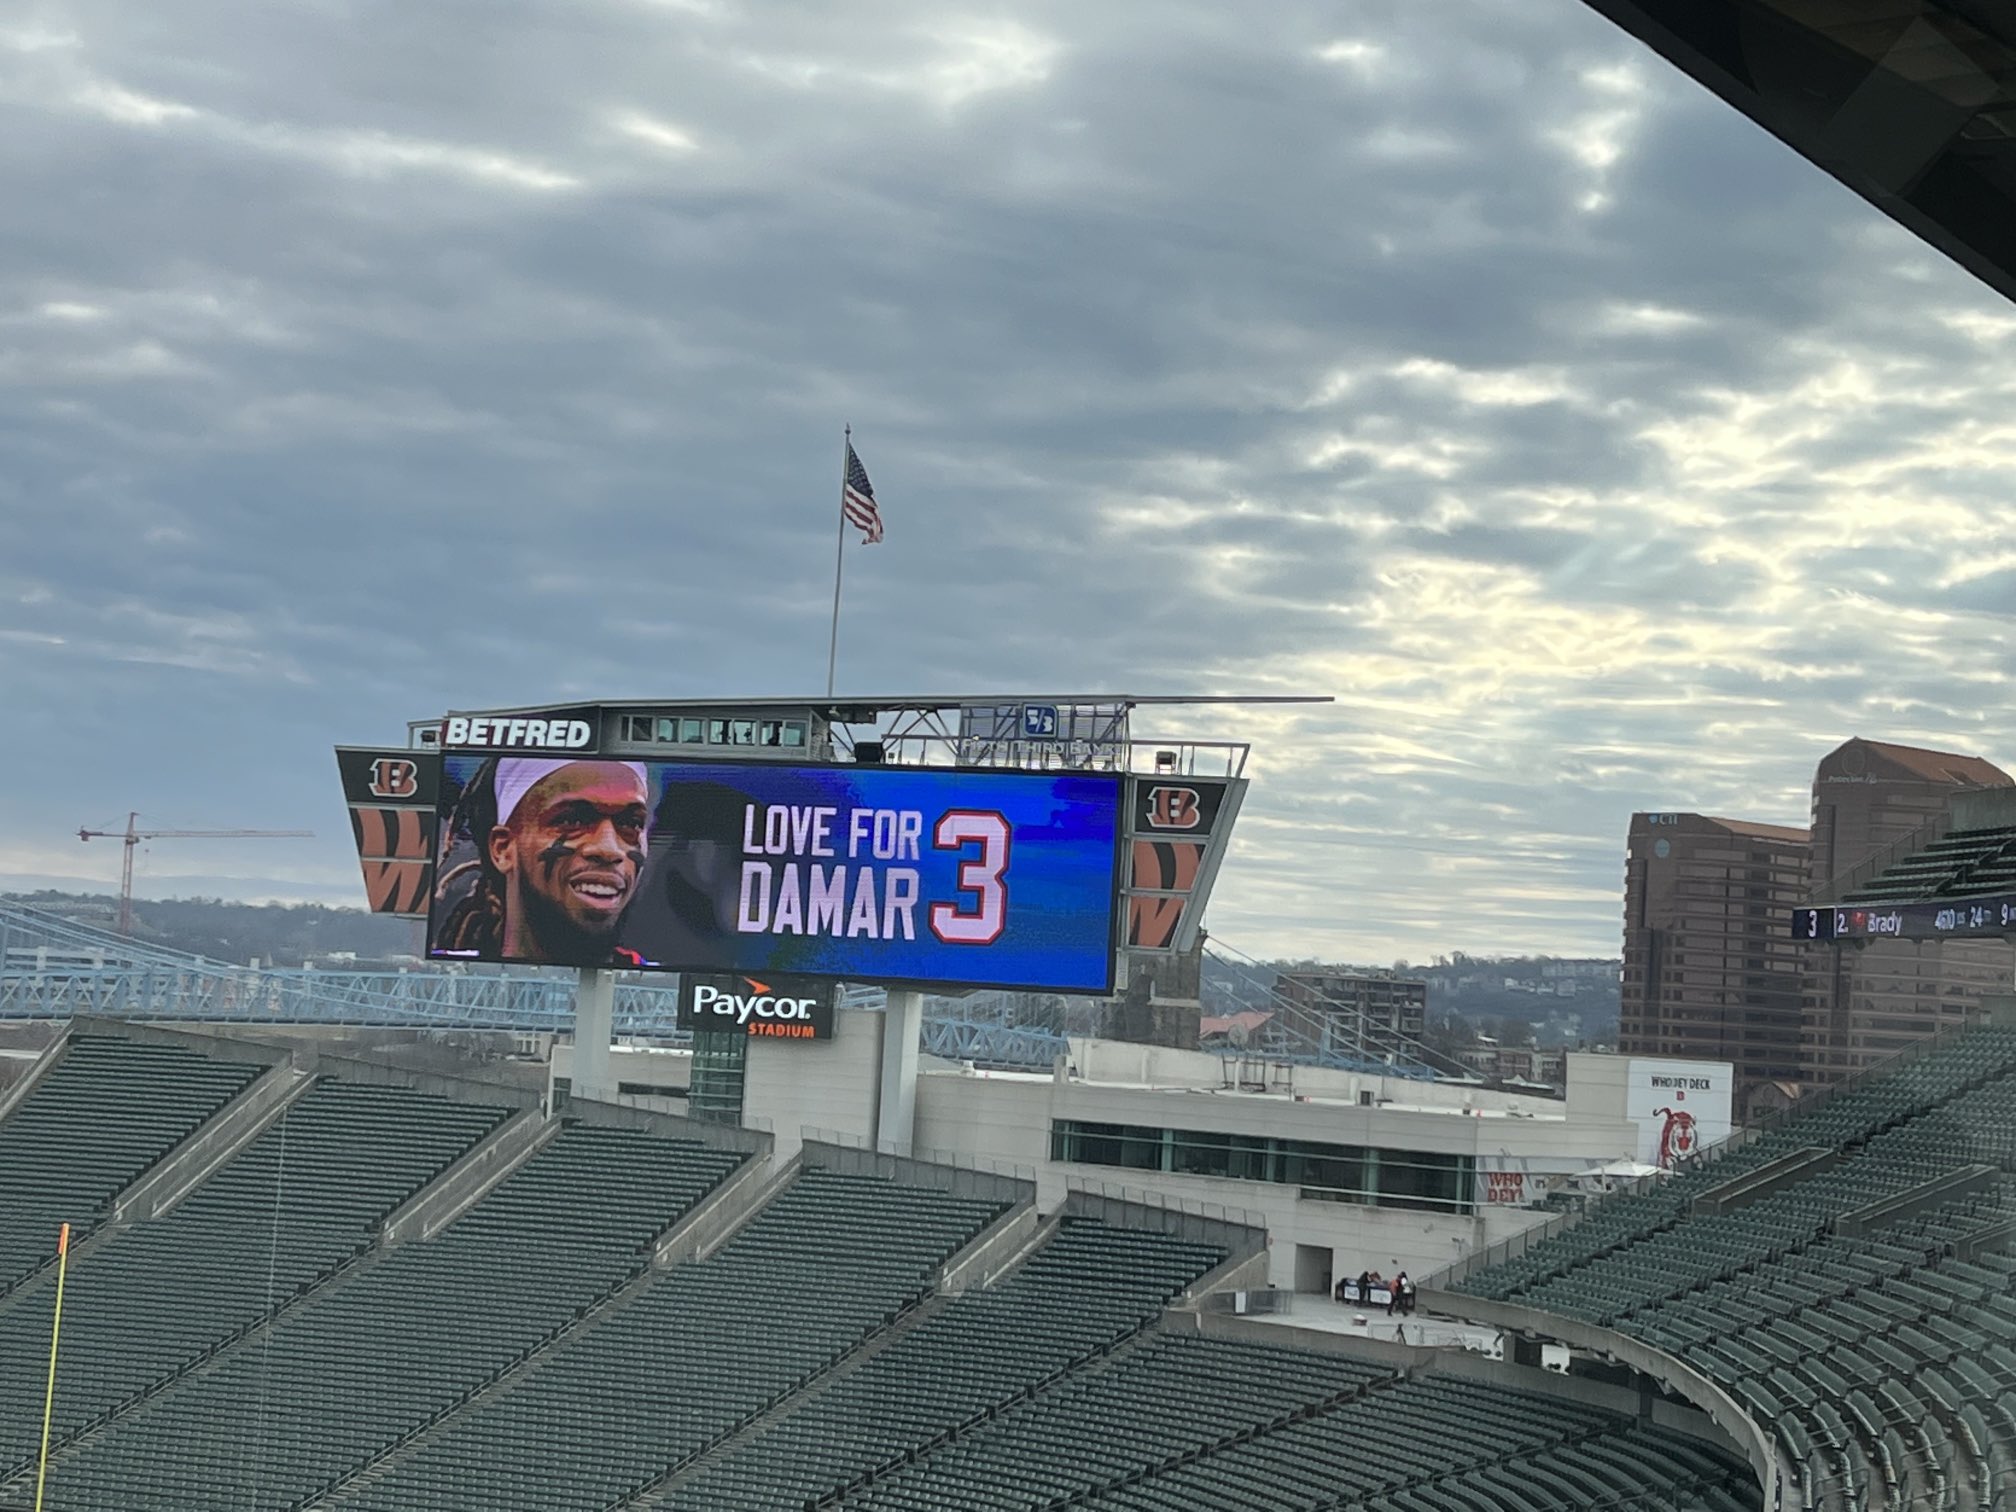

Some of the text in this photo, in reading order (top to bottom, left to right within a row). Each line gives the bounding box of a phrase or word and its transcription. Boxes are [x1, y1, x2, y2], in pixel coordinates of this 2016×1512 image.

[446, 717, 591, 748] BETFRED
[1015, 740, 1064, 755] THIRD
[368, 758, 418, 797] B
[1146, 786, 1201, 829] B
[743, 803, 923, 861] LOVE FOR
[928, 808, 1012, 946] 3
[737, 860, 920, 941] DAMAR
[1807, 909, 1818, 938] 3
[1867, 911, 1903, 937] Brady
[1969, 905, 1983, 928] 24
[2001, 903, 2009, 926] 9
[748, 1022, 815, 1039] STADIUM
[1651, 1076, 1673, 1088] WHO
[1689, 1078, 1711, 1090] DECK
[1488, 1173, 1523, 1187] WHO
